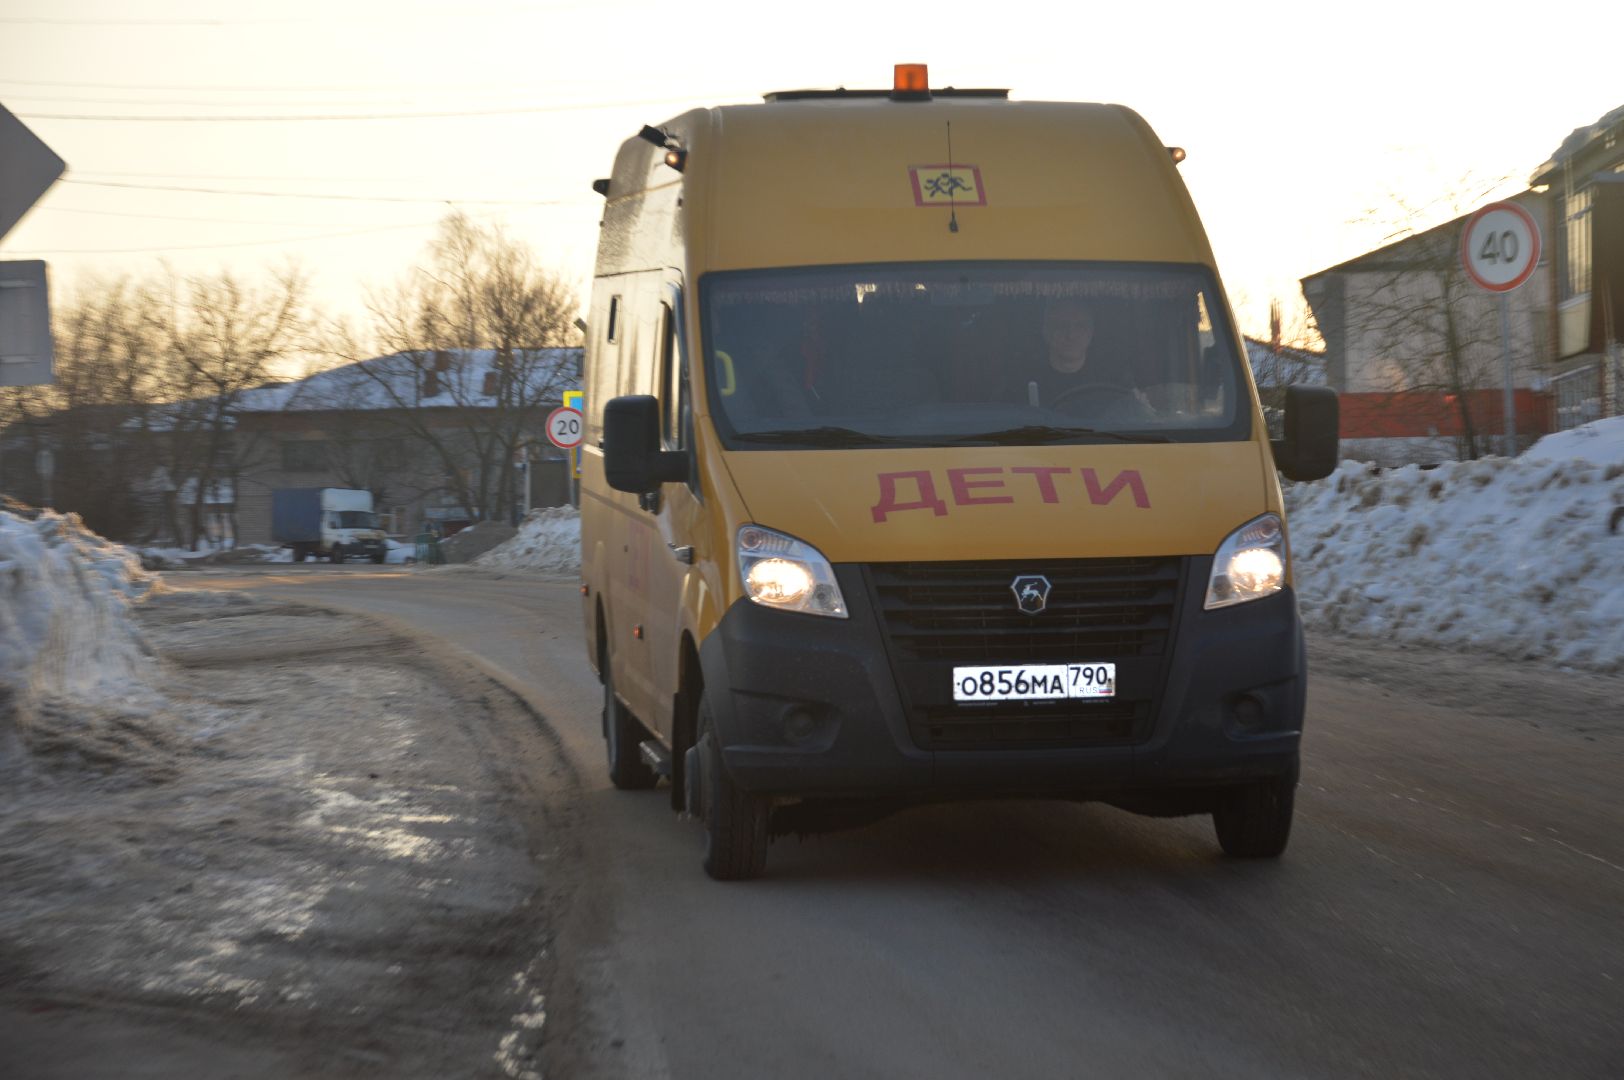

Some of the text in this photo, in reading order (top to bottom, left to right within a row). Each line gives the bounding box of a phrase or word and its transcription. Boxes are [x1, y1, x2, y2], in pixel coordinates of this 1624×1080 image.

[1478, 230, 1519, 265] 40
[557, 419, 579, 435] 20
[870, 467, 1151, 523] ДЕТИ
